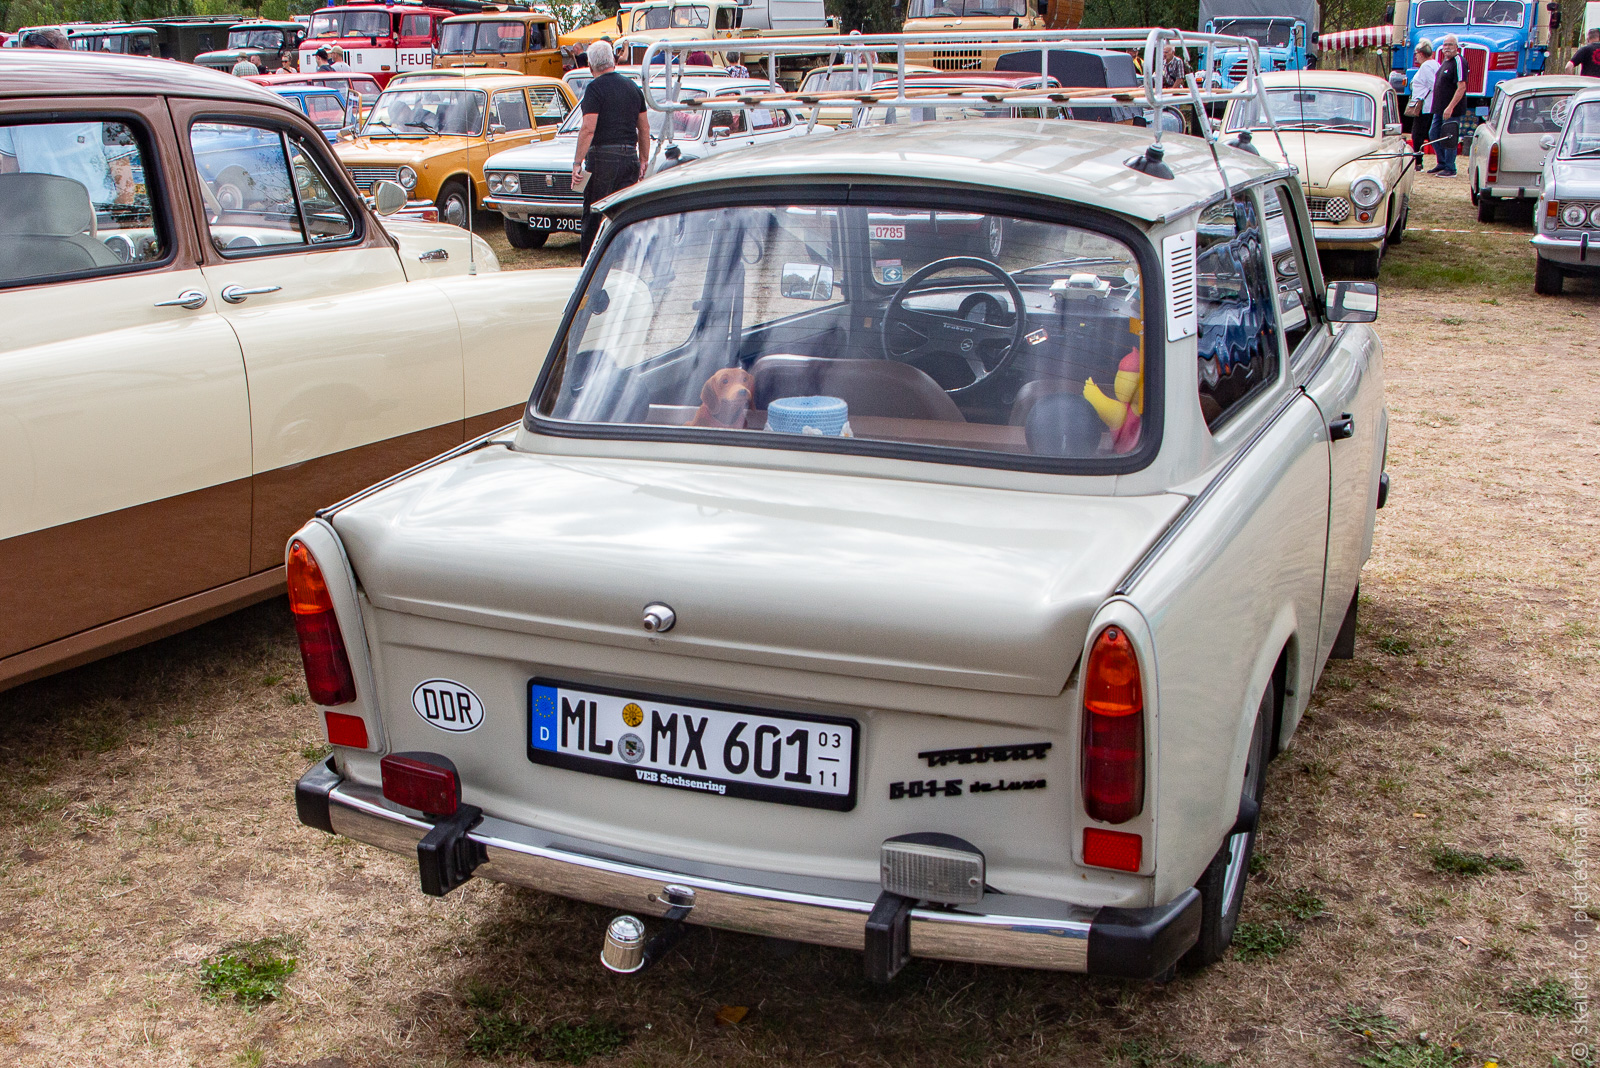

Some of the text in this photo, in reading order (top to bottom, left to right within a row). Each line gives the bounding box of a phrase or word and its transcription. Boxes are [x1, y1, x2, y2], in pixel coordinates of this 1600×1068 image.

[529, 216, 581, 231] SZD 290E
[876, 227, 903, 238] 0785
[422, 688, 475, 726] DDR
[539, 726, 549, 742] D
[561, 696, 811, 784] ML MX 601
[818, 731, 841, 749] 03
[636, 768, 727, 795] VEB Sachsenring
[819, 770, 838, 787] 11
